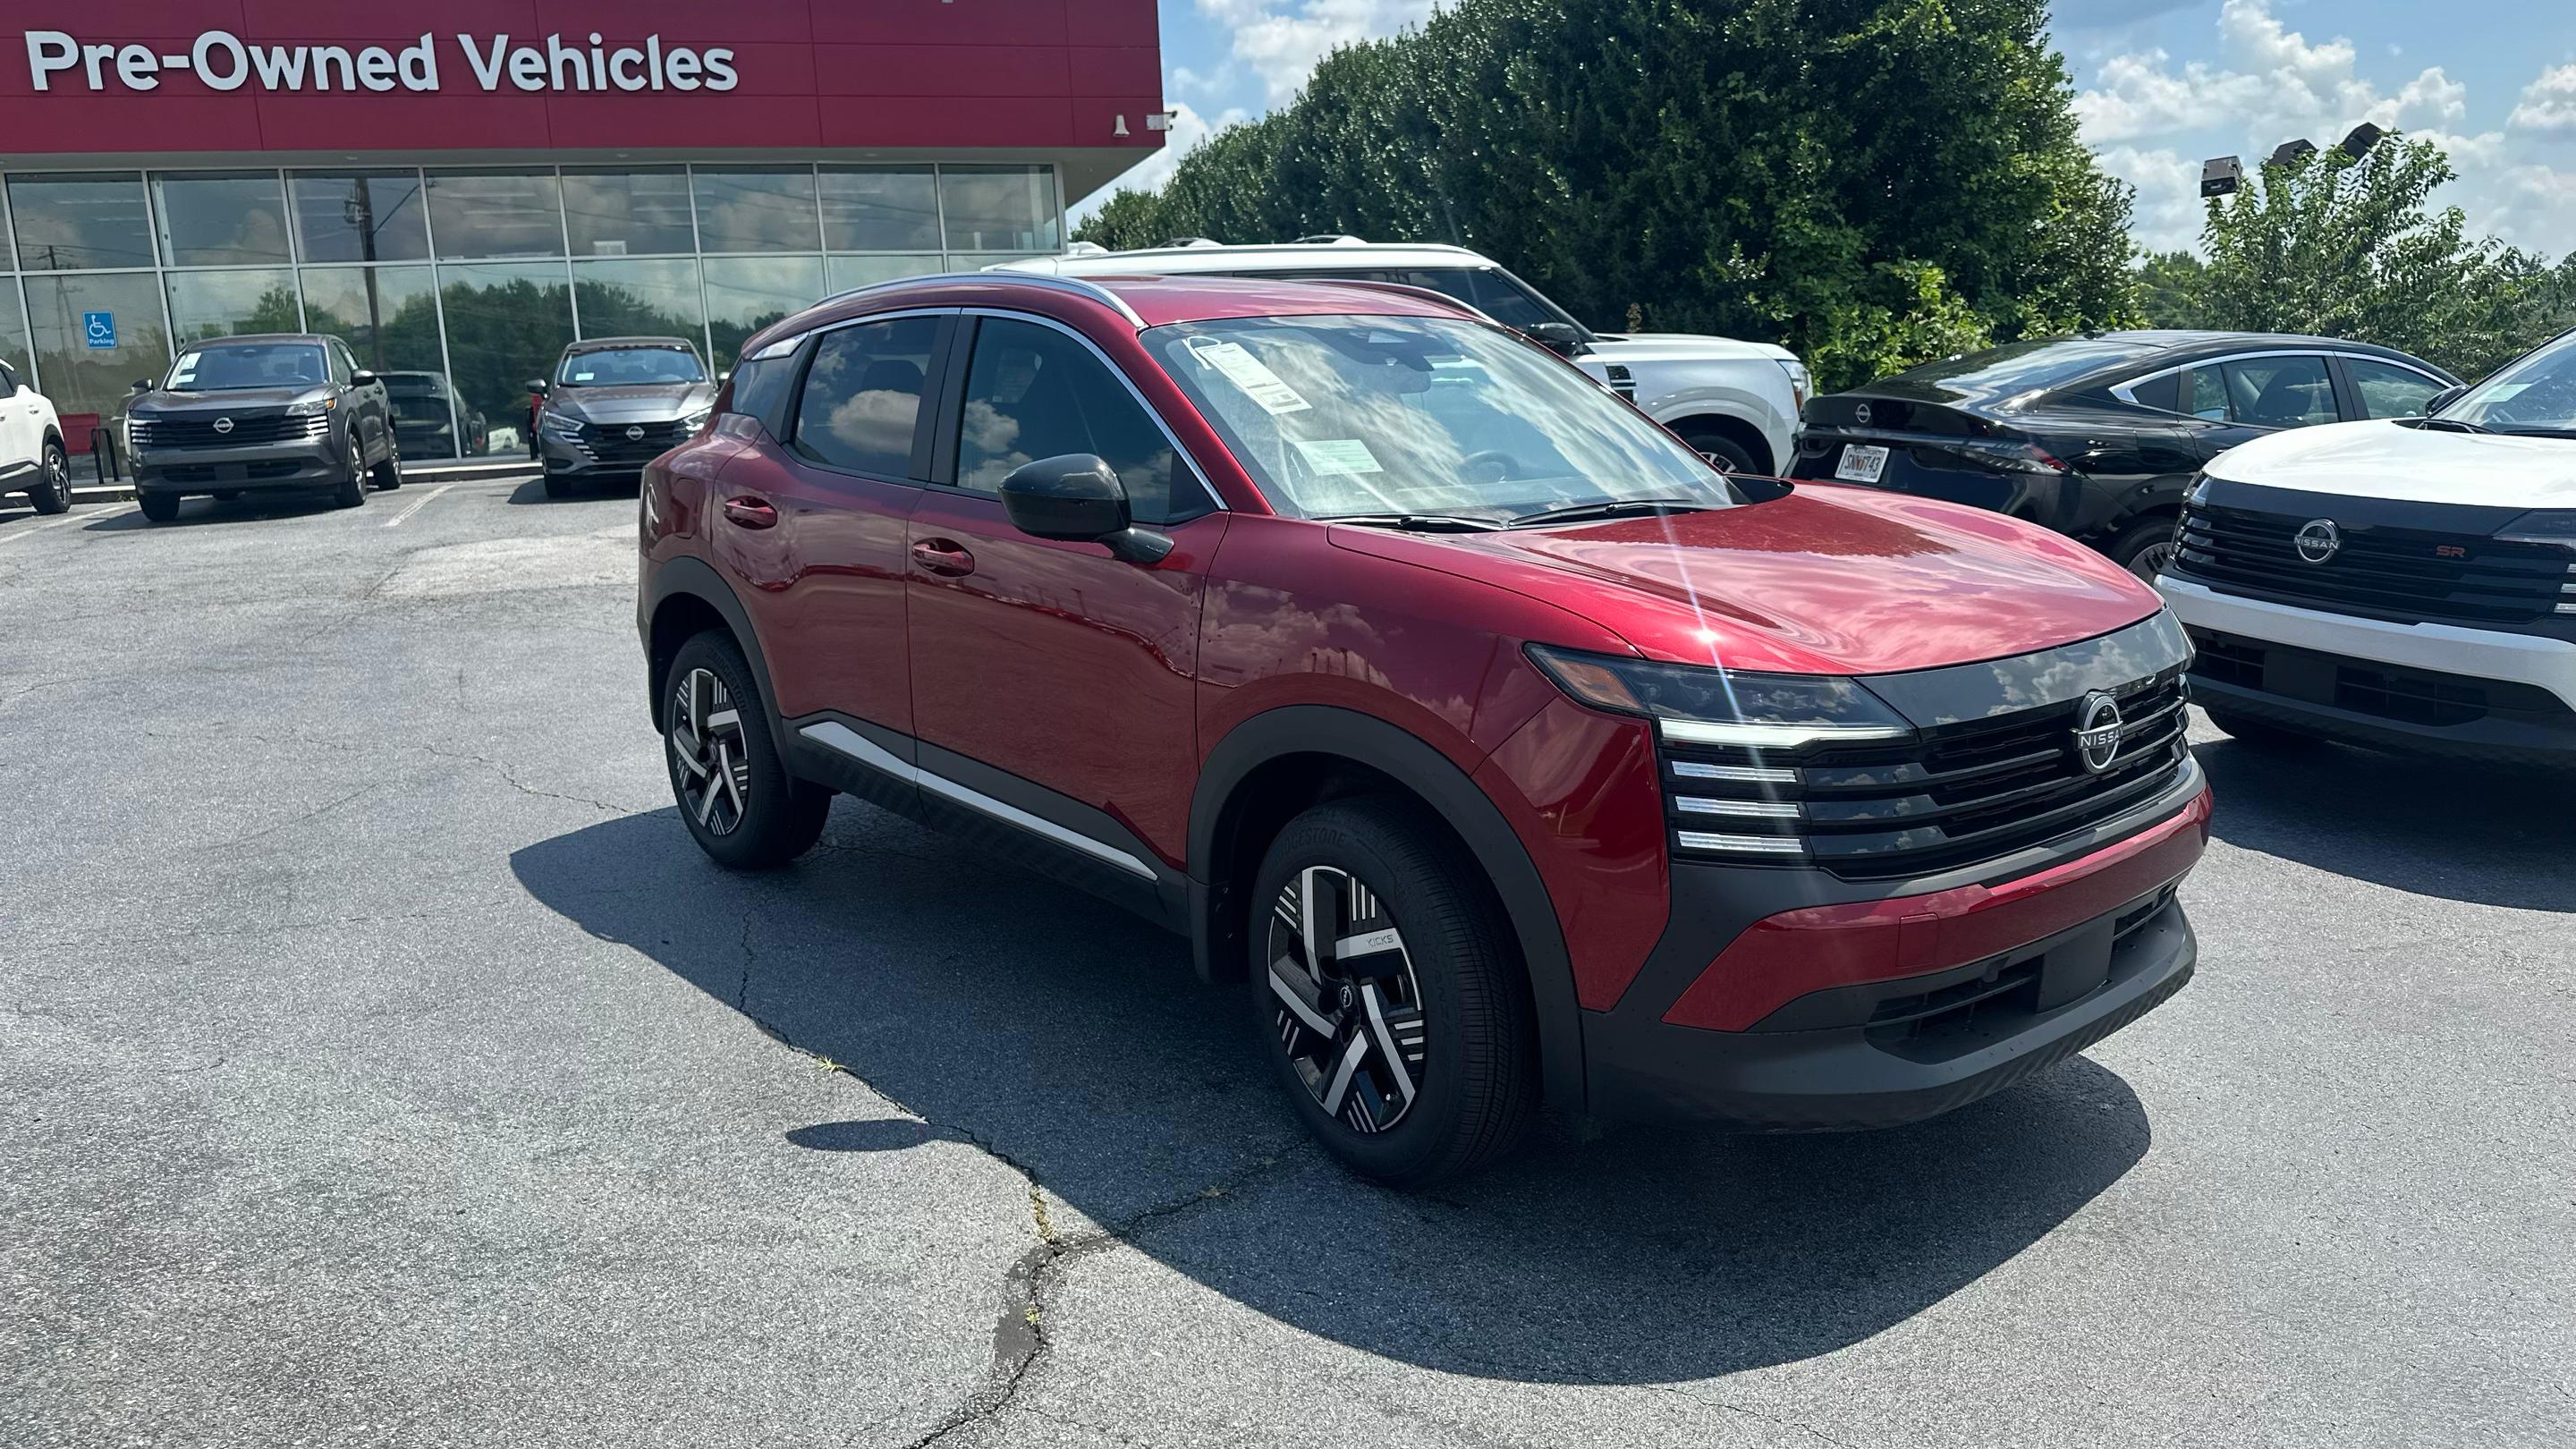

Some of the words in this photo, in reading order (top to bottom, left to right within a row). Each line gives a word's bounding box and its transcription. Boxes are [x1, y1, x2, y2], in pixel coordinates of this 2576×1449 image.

[25, 30, 439, 91] Pre-Owned
[457, 32, 739, 91] Vehicles
[2294, 537, 2338, 549] NISSAN
[2436, 546, 2465, 557] SR
[1367, 934, 1394, 949] KICKS
